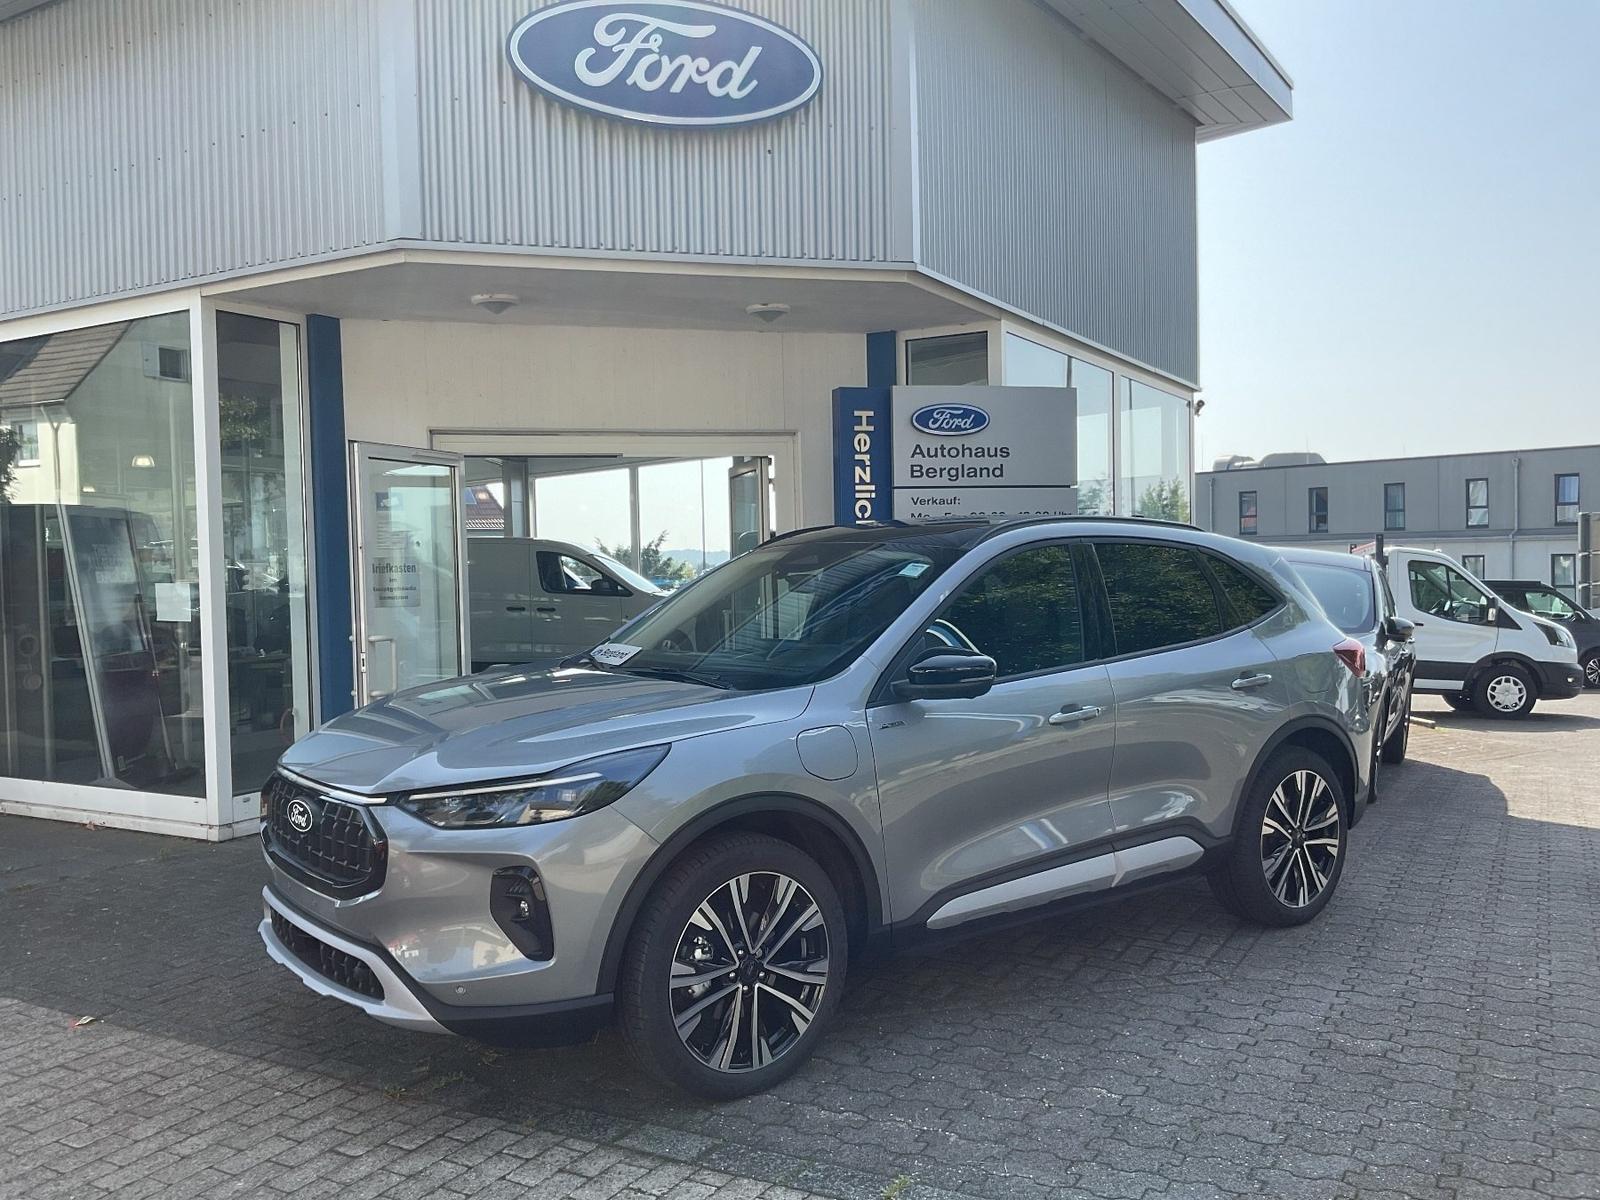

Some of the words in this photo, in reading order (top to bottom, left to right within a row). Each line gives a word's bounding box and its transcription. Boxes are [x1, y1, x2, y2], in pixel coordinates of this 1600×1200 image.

[574, 12, 763, 100] Ford
[928, 408, 974, 430] Ford
[910, 444, 1011, 459] Autohaus
[853, 410, 877, 525] Herzlic
[910, 464, 1004, 482] Bergland
[911, 496, 961, 506] Verkauf:
[291, 803, 308, 827] Ford
